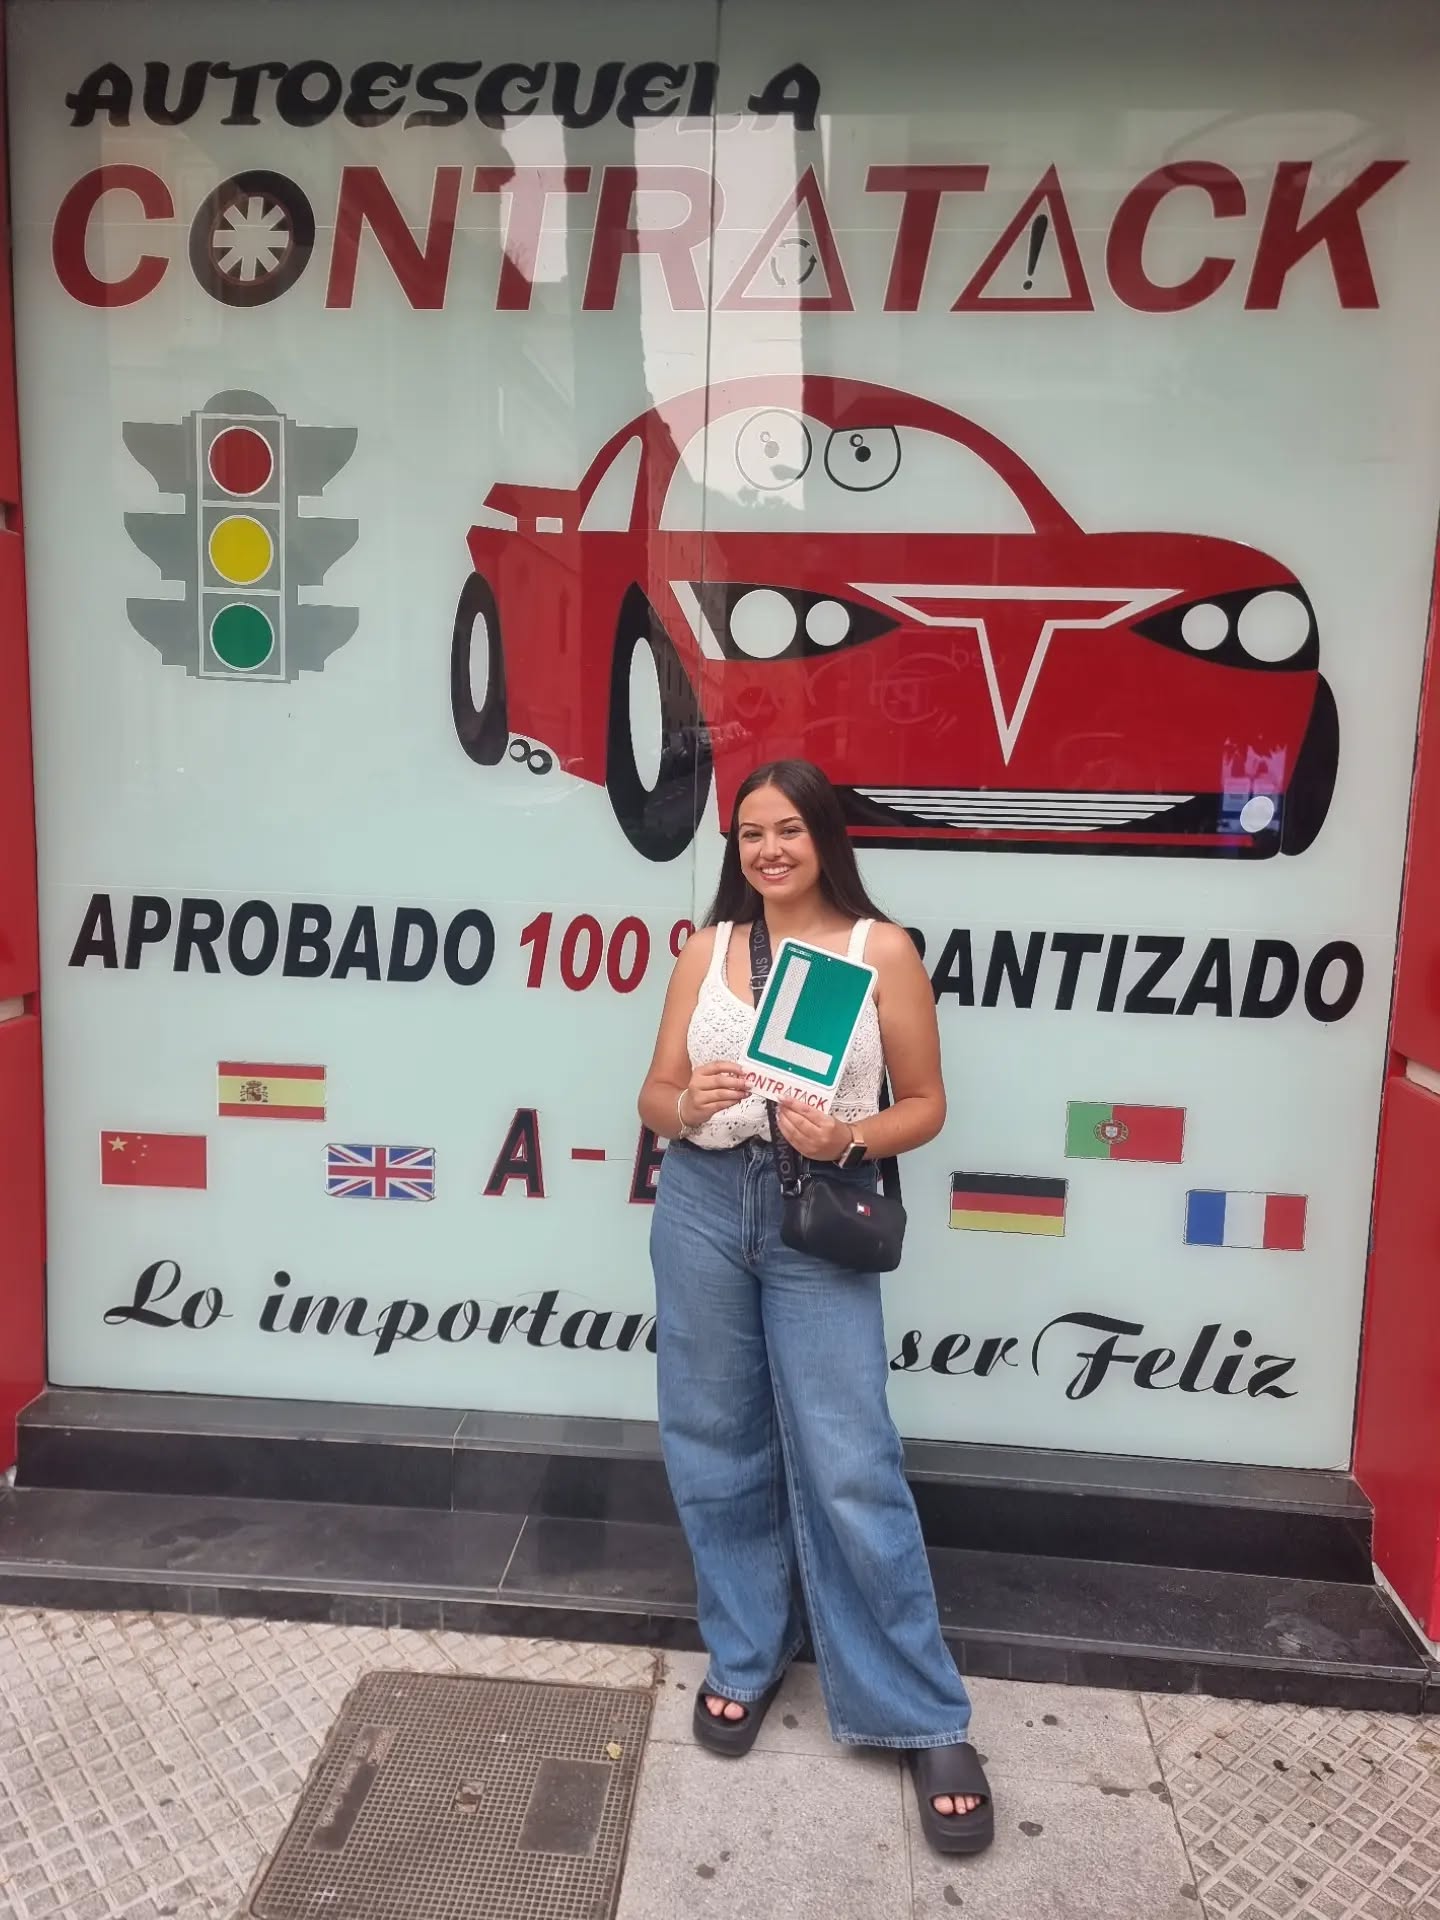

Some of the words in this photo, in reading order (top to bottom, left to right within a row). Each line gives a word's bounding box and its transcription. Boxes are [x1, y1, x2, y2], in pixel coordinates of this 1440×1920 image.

[66, 60, 822, 131] AUTOESCUELA
[51, 160, 1409, 312] CONTRATACK
[68, 893, 496, 986] APROBADO
[903, 927, 1364, 1022] ANTIZADO
[758, 955, 833, 1076] L
[744, 1071, 828, 1112] ONTRATACK
[483, 1107, 546, 1198] A
[103, 1259, 233, 1330] Lo
[259, 1270, 657, 1357] importan
[889, 1329, 1019, 1377] ser
[1031, 1311, 1298, 1400] Feliz
